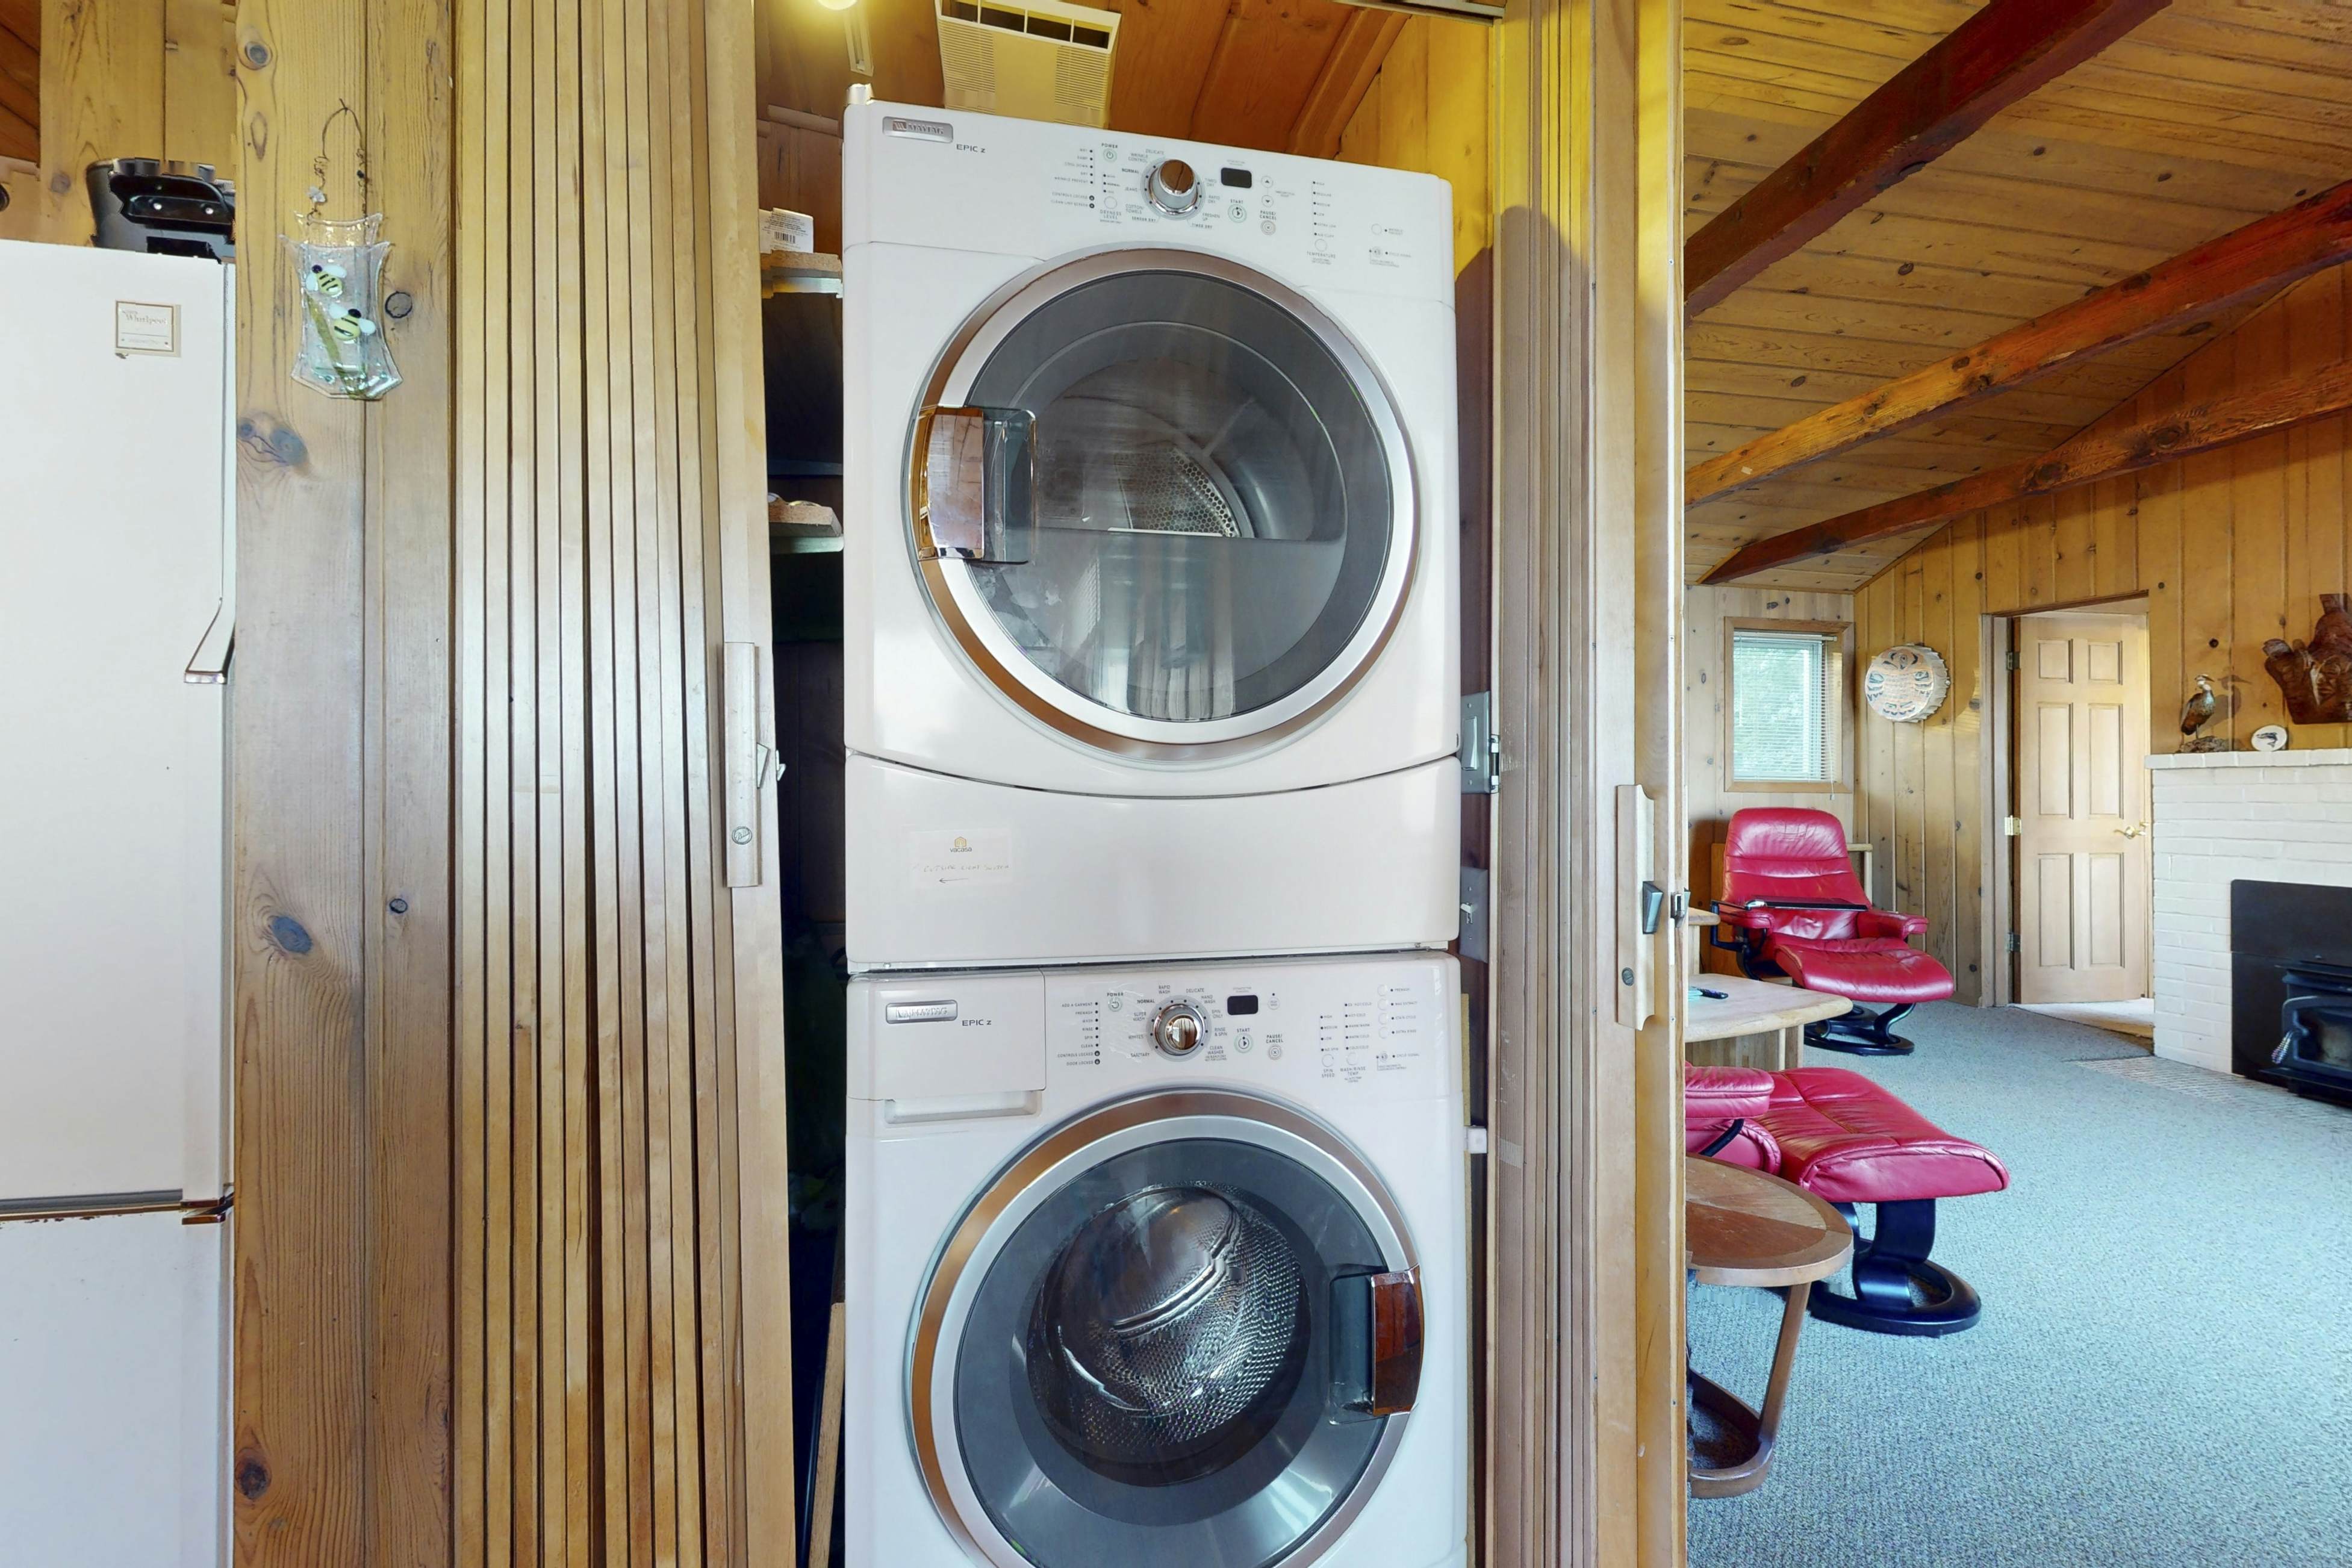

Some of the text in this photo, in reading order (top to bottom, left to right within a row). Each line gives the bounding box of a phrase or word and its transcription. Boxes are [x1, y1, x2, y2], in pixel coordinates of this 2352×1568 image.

[908, 124, 944, 134] MAYTAG
[122, 310, 167, 325] Whirlpool
[911, 1007, 948, 1017] MAYTAG
